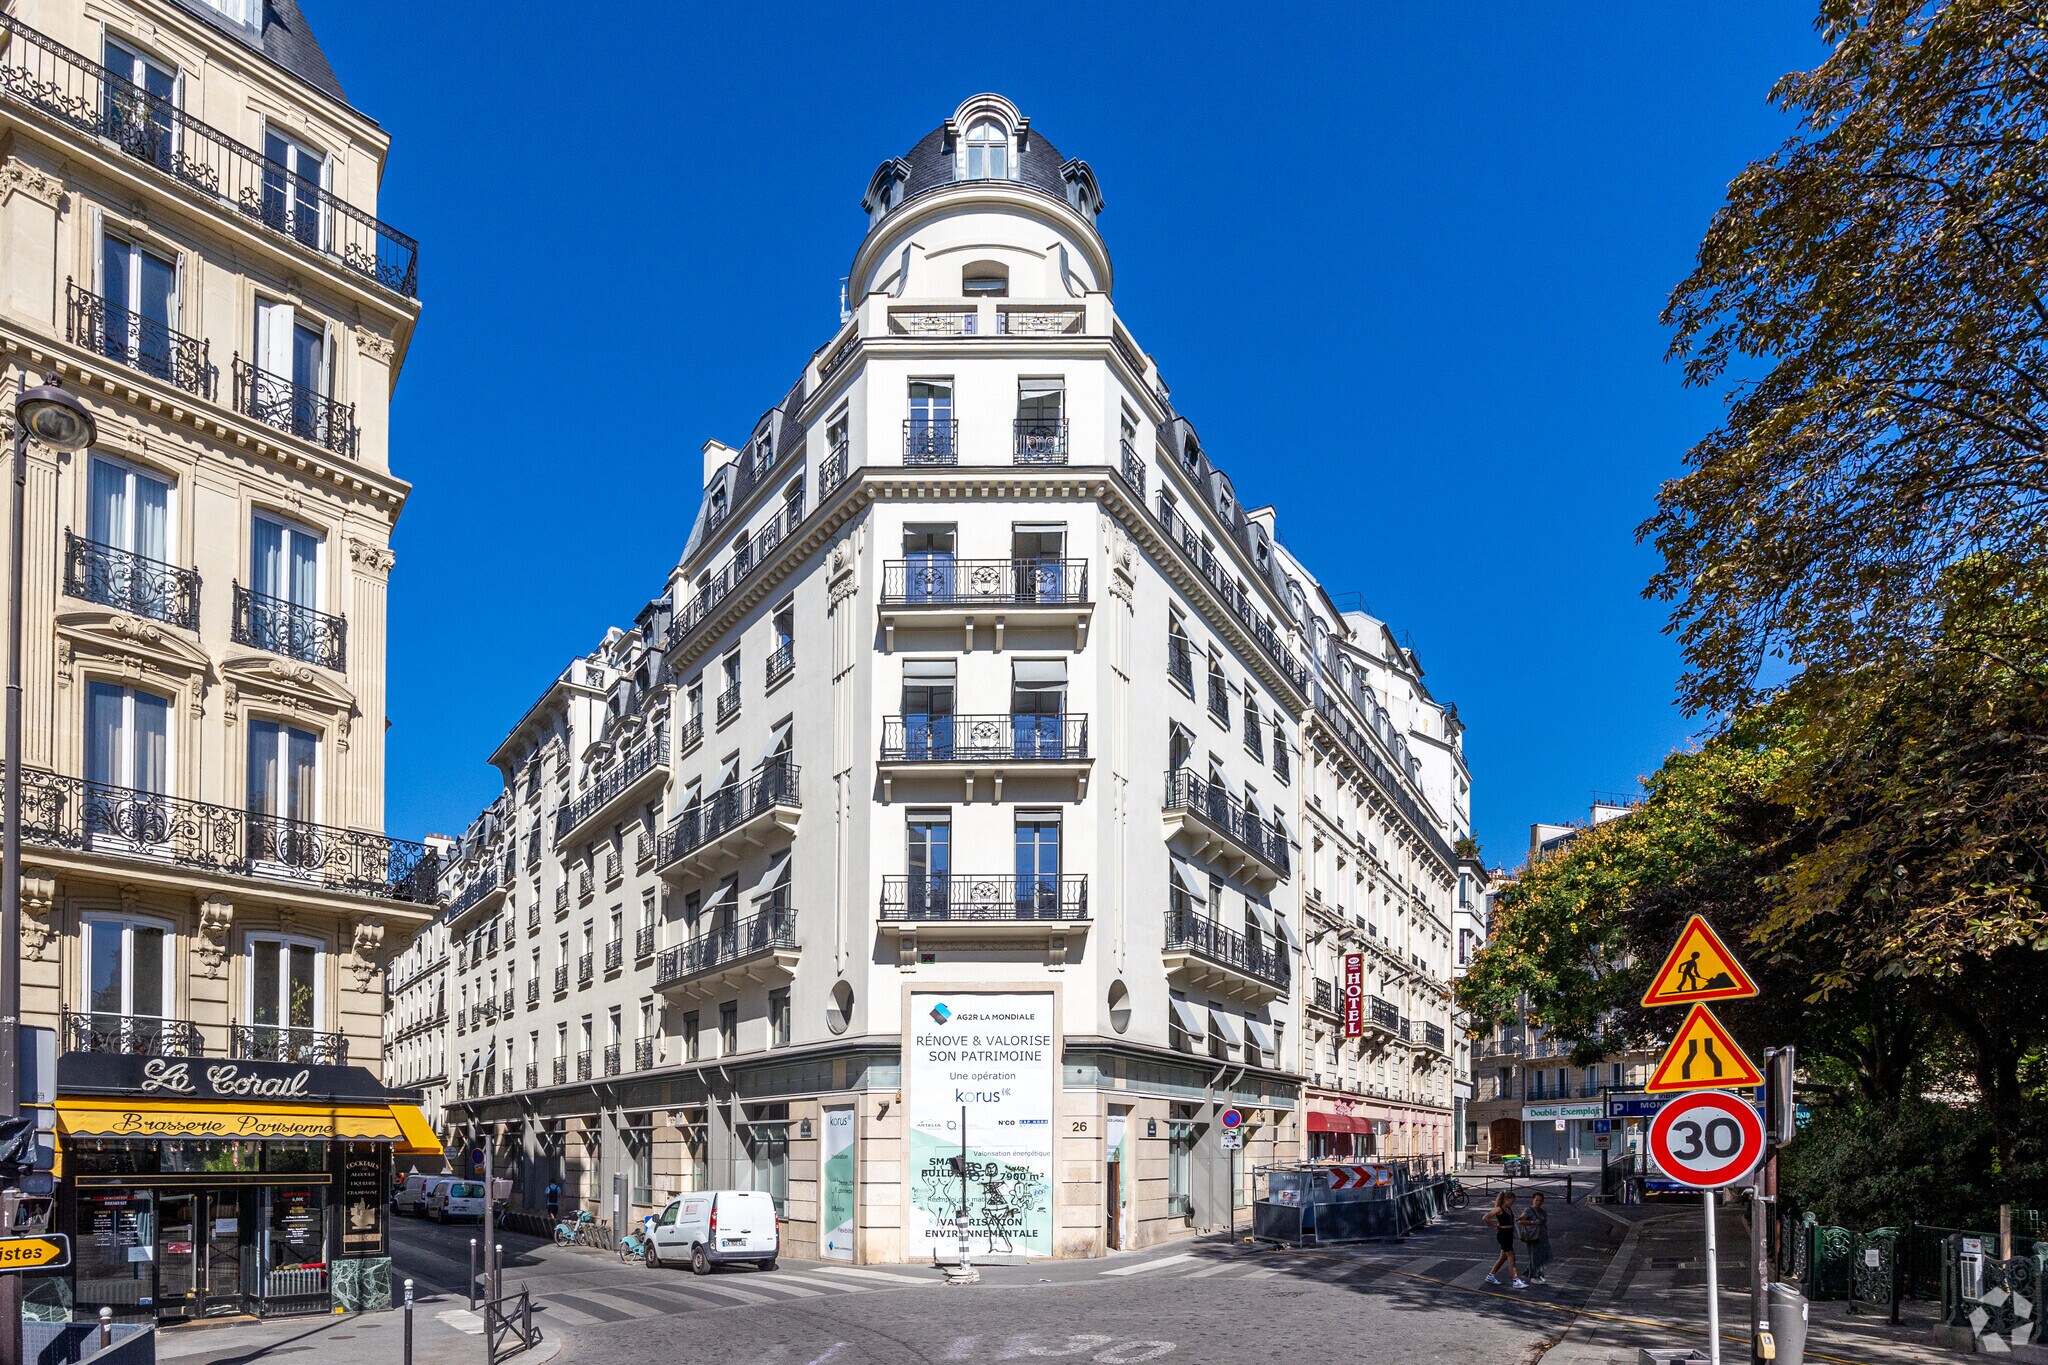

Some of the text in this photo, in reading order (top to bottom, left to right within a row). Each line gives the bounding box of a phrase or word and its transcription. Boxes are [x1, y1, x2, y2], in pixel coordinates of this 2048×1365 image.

[1346, 973, 1361, 1034] HOTEL
[916, 1033, 1050, 1046] RÉNOVE & VALORISE
[929, 1051, 1042, 1062] SON PATRIMOINE
[141, 1058, 310, 1099] Le Corail
[949, 1071, 1016, 1081] Une opération
[955, 1088, 1000, 1102] korus
[1530, 1108, 1557, 1117] Double
[1613, 1103, 1624, 1115] P
[112, 1112, 336, 1134] Brasserie Parisienne
[1072, 1121, 1088, 1132] 26
[1672, 1117, 1742, 1161] 30
[1012, 1149, 1051, 1157] énergétique
[346, 1160, 380, 1170] COCKTAILS
[1000, 1172, 1044, 1180] 7900 m²
[925, 1229, 1039, 1238] ENVIRNNEMENTALE
